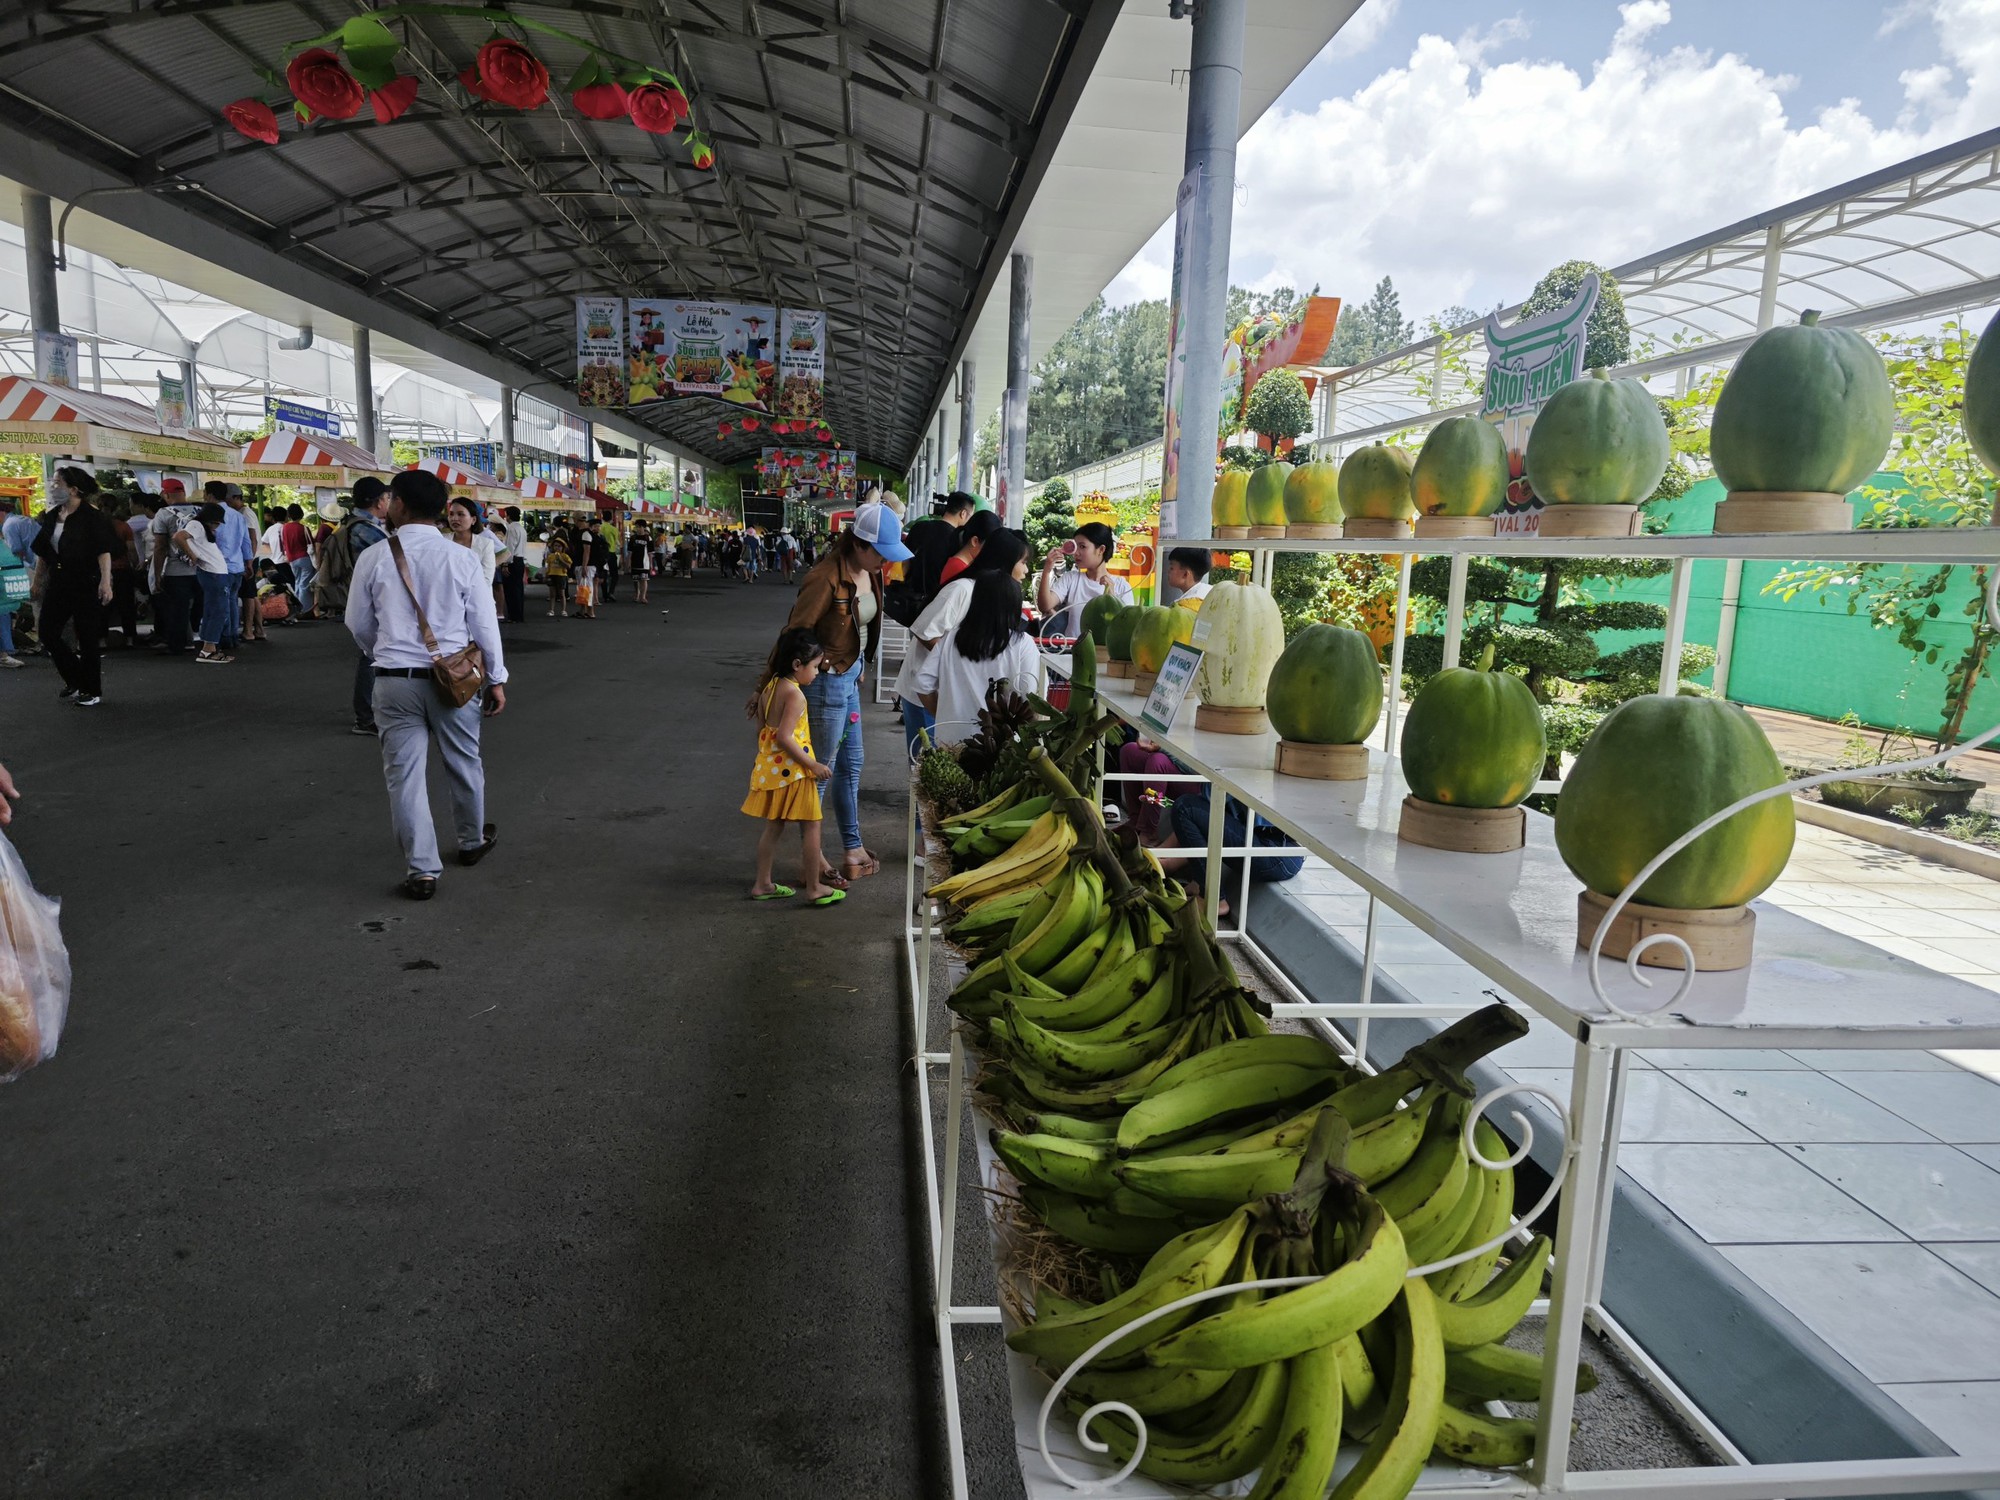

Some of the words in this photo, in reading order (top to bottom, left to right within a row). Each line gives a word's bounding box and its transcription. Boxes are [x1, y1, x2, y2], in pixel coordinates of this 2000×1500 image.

[686, 314, 697, 326] Lễ
[698, 315, 713, 328] Hội
[677, 343, 697, 356] SUỐI
[700, 345, 720, 357] TIÊN
[675, 354, 722, 376] FARM
[1487, 358, 1527, 411] SUỐI
[1529, 338, 1577, 402] TIÊN
[0, 432, 48, 444] STIVAL
[49, 433, 79, 445] 2023
[251, 470, 276, 478] FARM
[276, 471, 318, 480] FESTIVAL
[318, 472, 338, 481] 2023
[1494, 516, 1520, 532] IVAL
[1524, 514, 1540, 532] 20
[1176, 657, 1193, 673] KHÁCH
